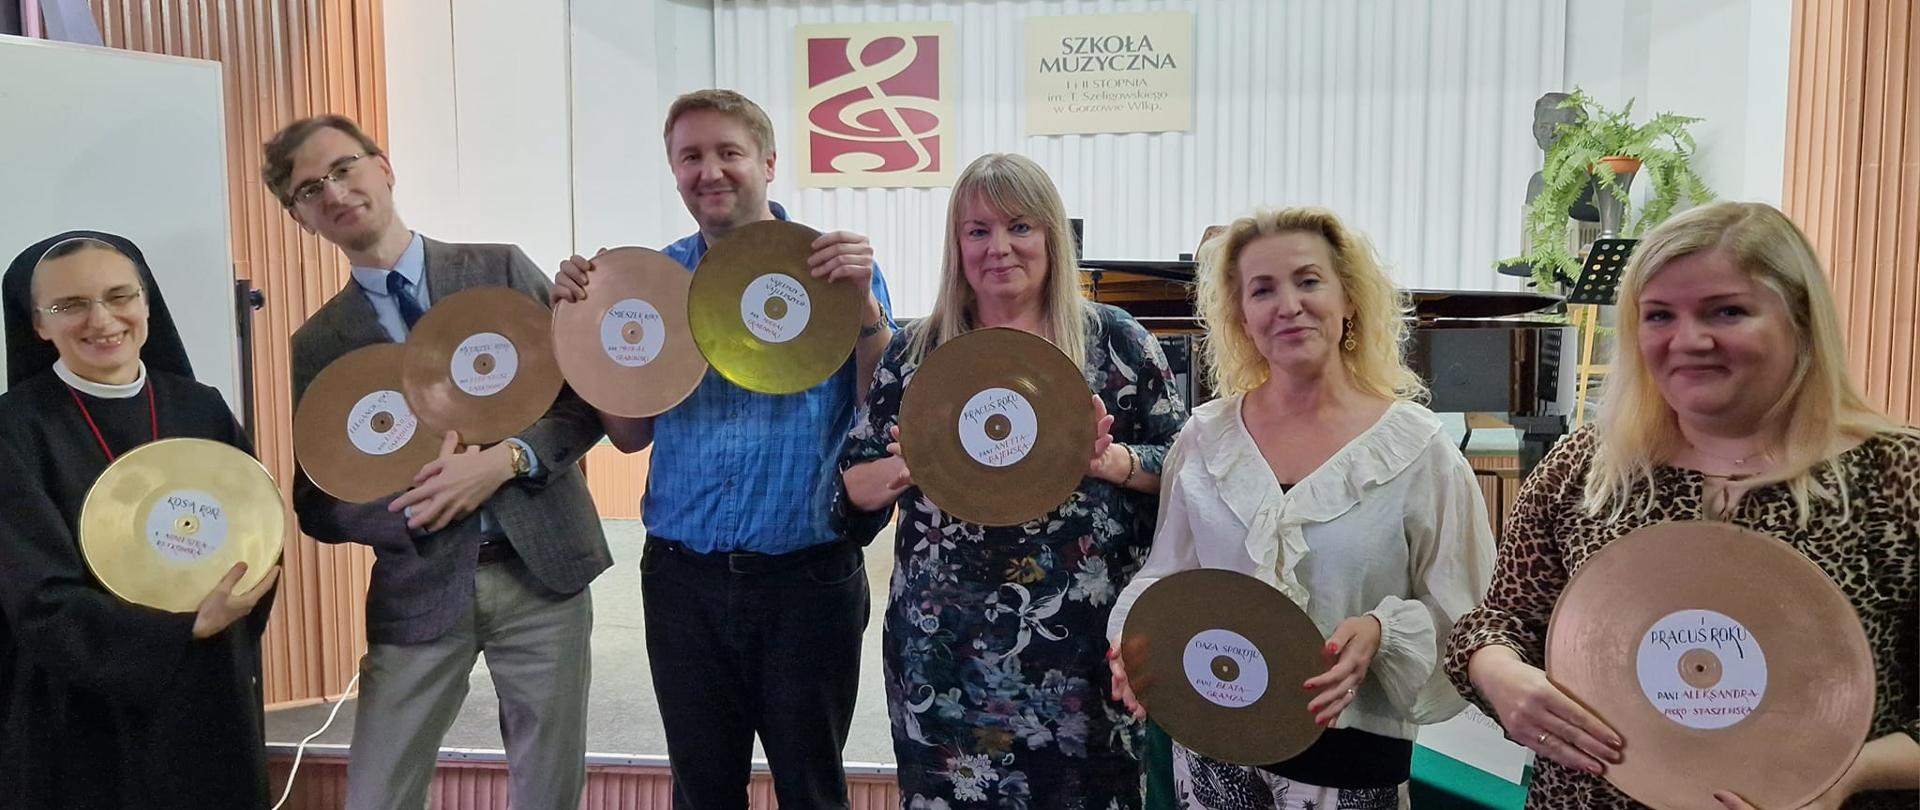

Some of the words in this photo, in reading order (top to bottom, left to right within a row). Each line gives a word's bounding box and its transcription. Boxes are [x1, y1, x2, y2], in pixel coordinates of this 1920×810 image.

[1062, 35, 1153, 55] SZKOŁA
[1039, 53, 1176, 73] MUZYCZNA
[1093, 78, 1148, 89] STOPNIA
[1083, 89, 1168, 103] Szeligowskiego
[1068, 101, 1124, 113] Gorzowie
[1127, 99, 1162, 112] Wlkp.
[1710, 625, 1747, 659] ROKU
[1683, 689, 1759, 703] ALEKSANDRA
